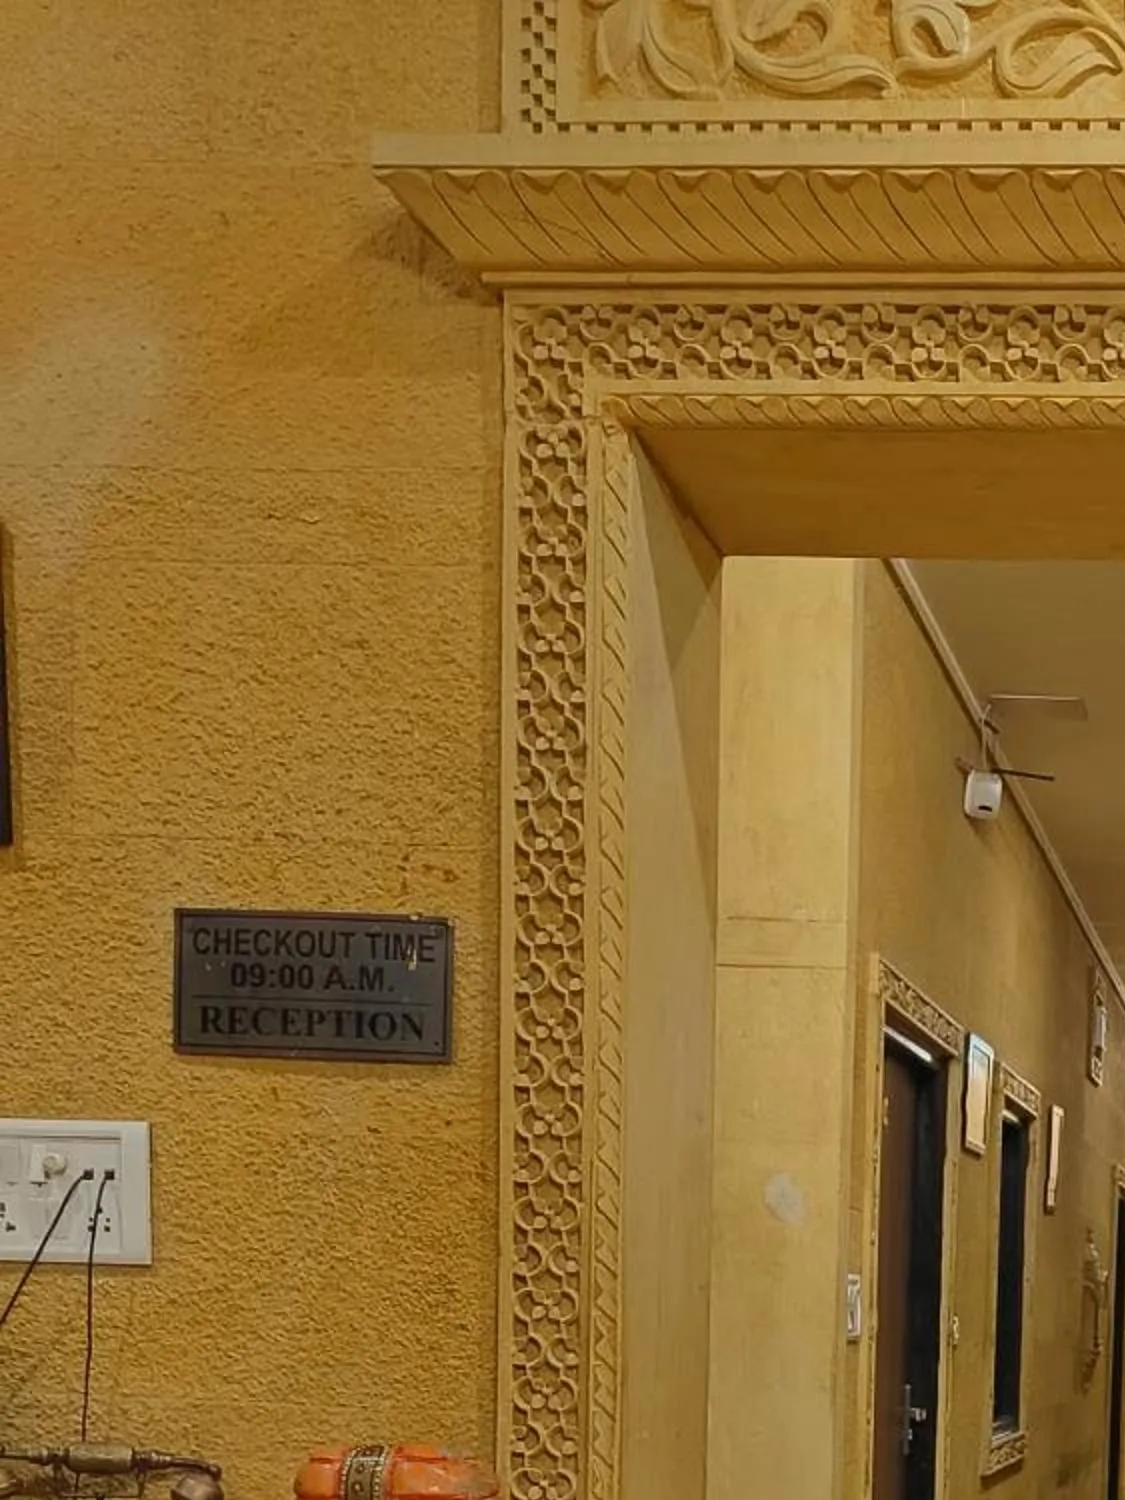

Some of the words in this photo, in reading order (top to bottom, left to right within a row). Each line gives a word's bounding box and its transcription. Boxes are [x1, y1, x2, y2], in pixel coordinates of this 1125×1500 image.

[192, 927, 356, 959] CHECKOUT
[365, 931, 435, 963] TIME
[230, 963, 314, 990] 09:00
[199, 1005, 425, 1041] RECEPTION
